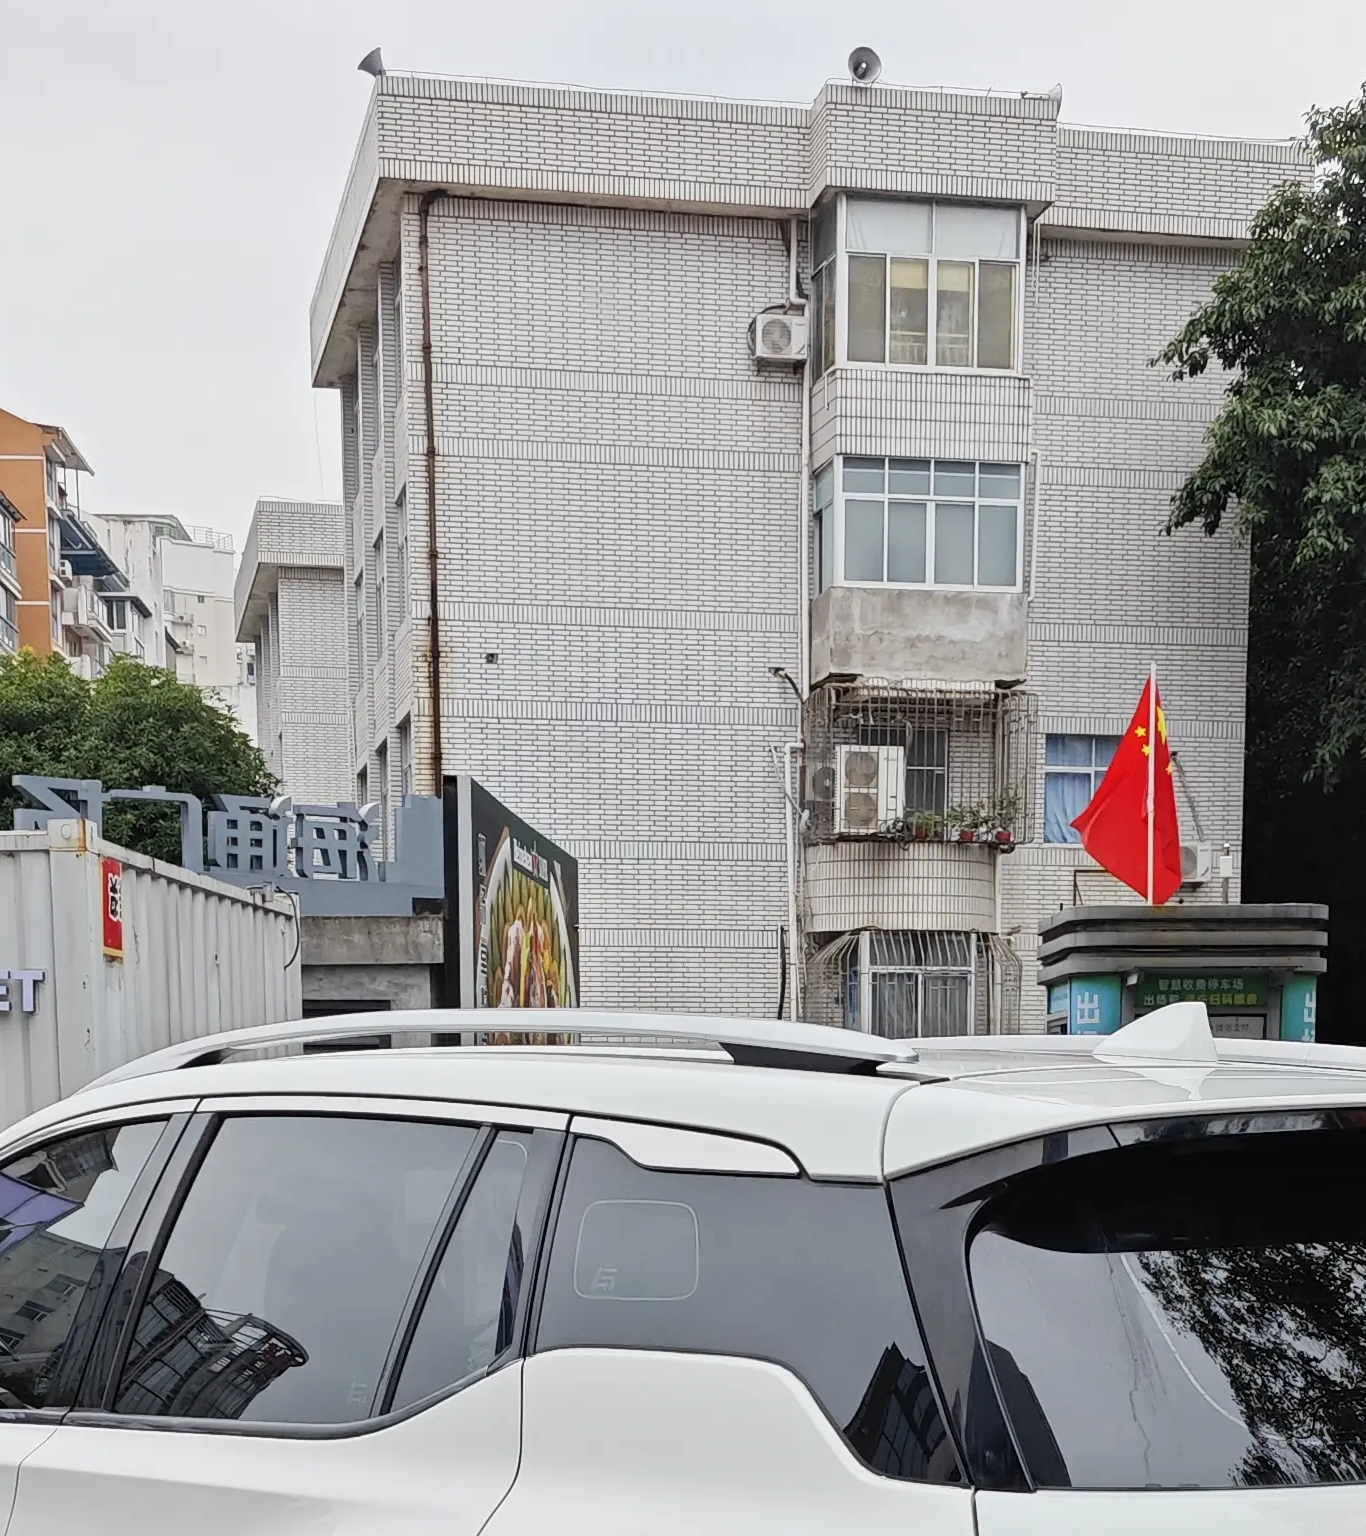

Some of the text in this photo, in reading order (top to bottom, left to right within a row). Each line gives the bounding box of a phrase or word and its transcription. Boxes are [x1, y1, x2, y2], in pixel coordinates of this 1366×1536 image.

[1158, 977, 1244, 991] 智慧收费停车场
